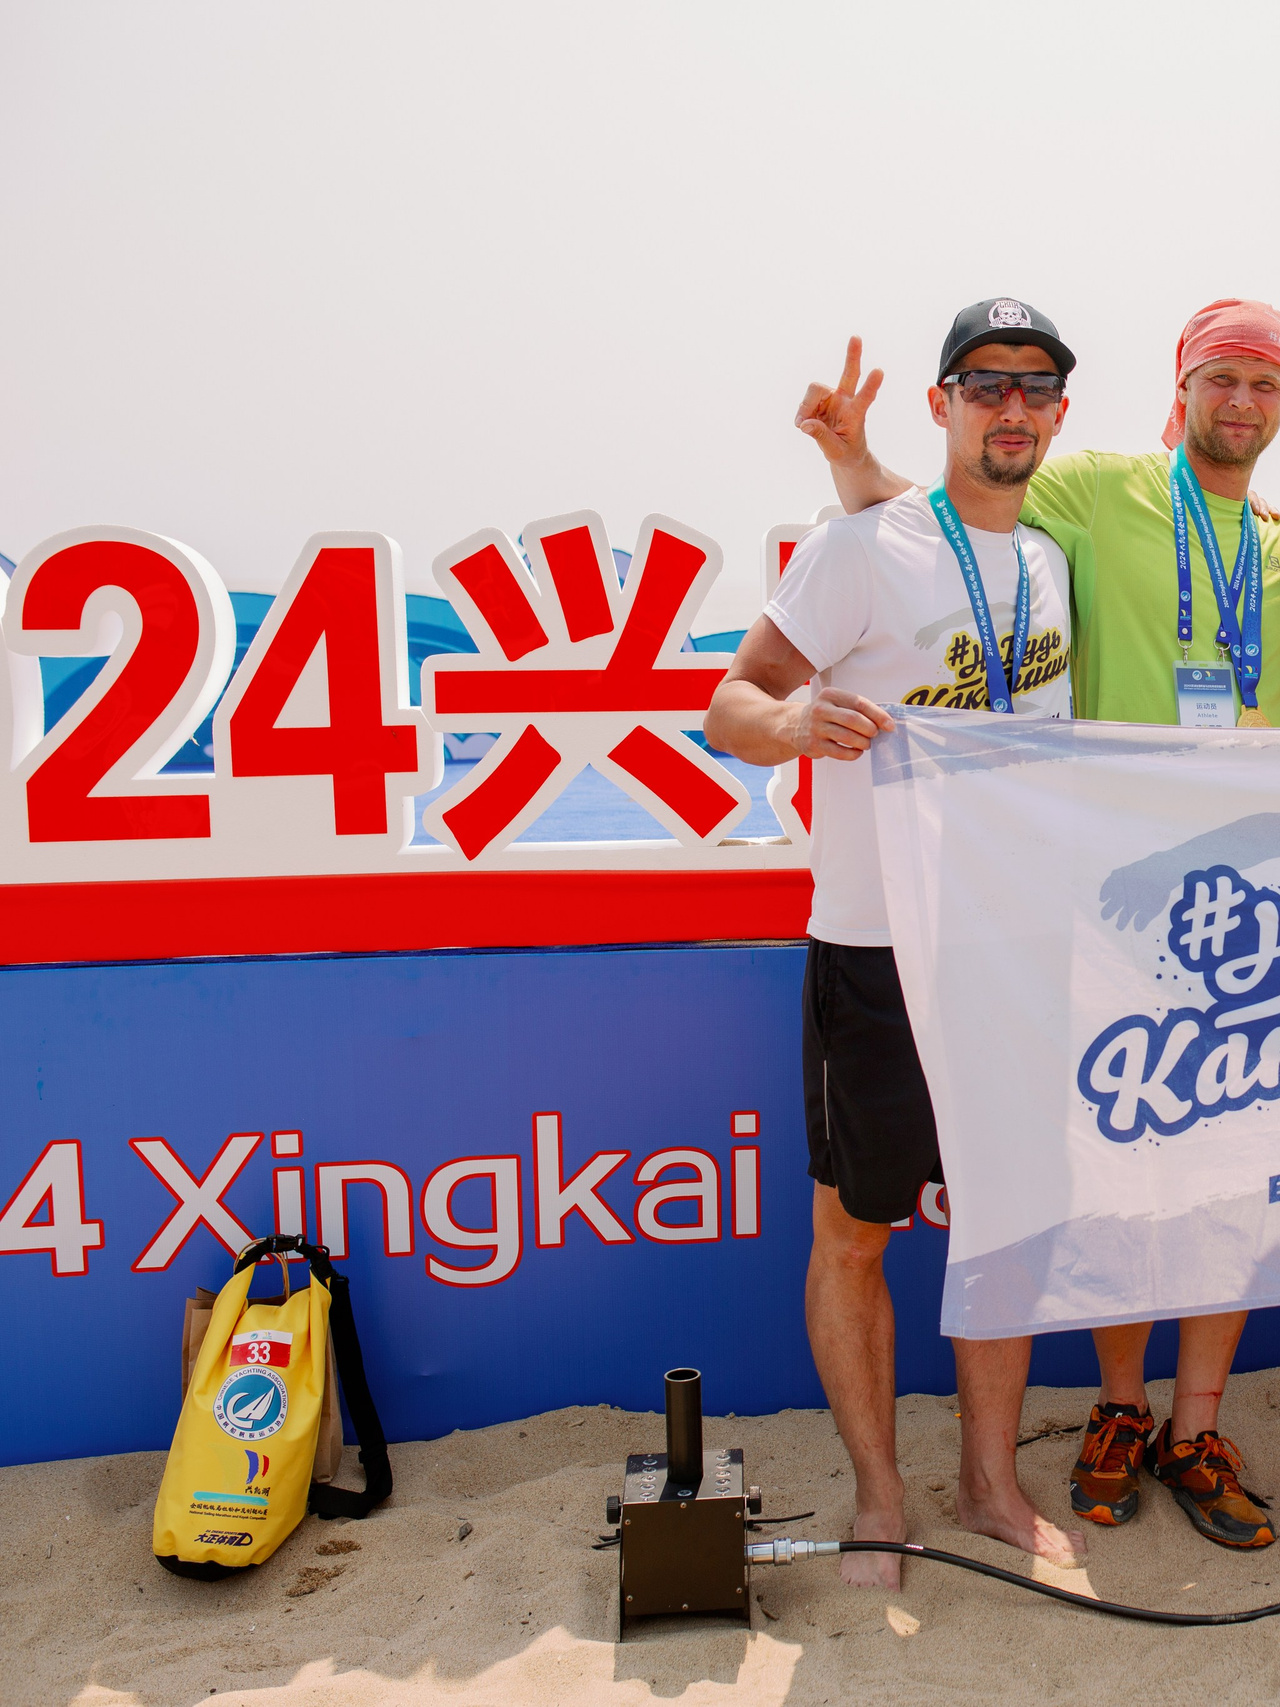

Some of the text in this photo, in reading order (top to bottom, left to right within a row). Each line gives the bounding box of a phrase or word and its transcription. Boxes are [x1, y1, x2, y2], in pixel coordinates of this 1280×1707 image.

[1212, 549, 1220, 568] National
[22, 526, 812, 861] 24兴
[128, 1111, 762, 1288] Xingkai
[246, 1341, 271, 1364] 33
[234, 1368, 267, 1379] YACHTING
[267, 1372, 287, 1409] ASSOCIATION
